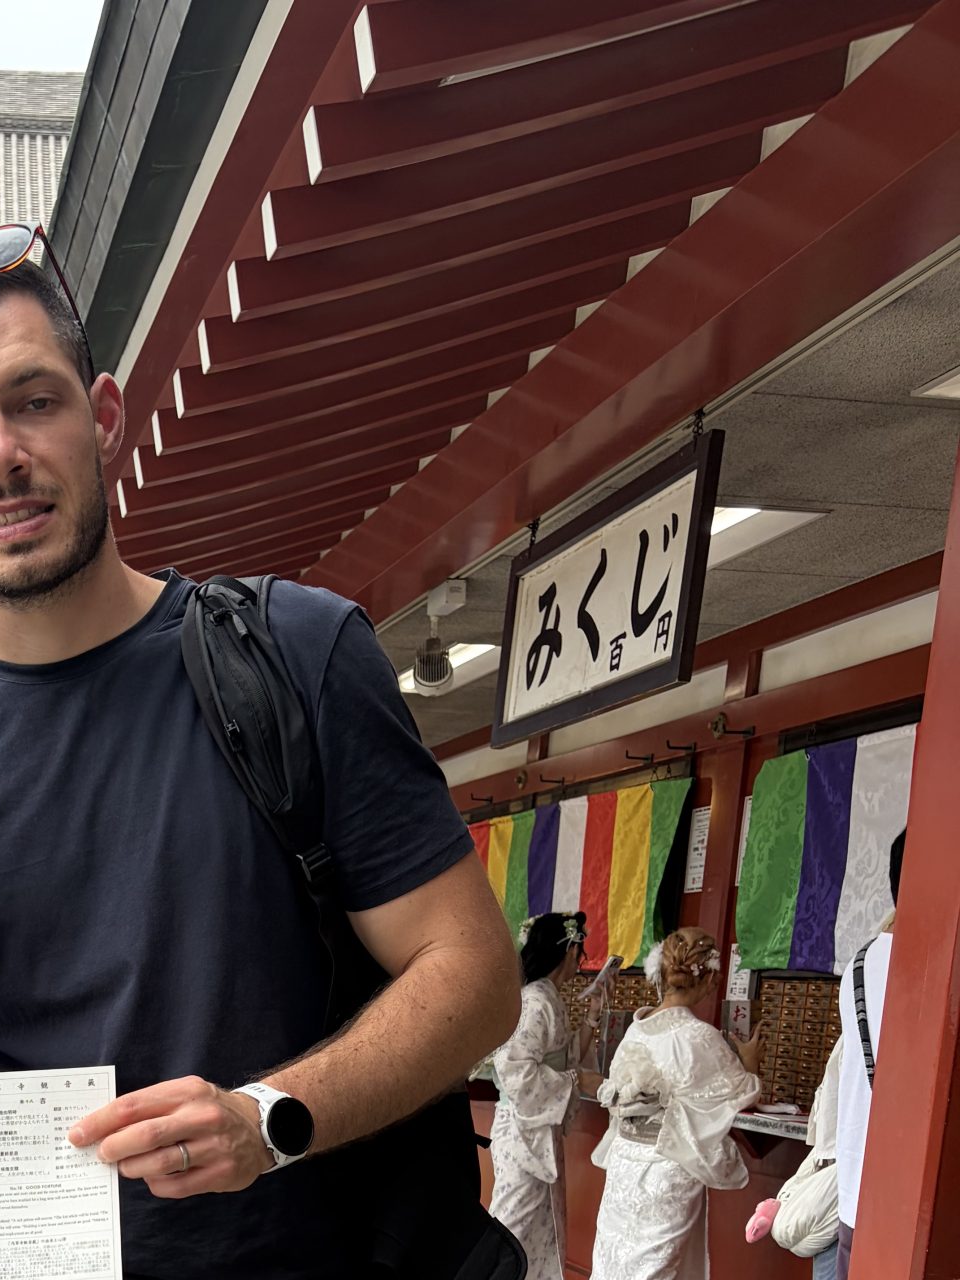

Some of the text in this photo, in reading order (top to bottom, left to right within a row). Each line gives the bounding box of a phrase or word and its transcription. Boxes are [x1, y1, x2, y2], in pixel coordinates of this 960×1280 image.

[525, 513, 678, 690] みくじ
[609, 609, 674, 673] 百円
